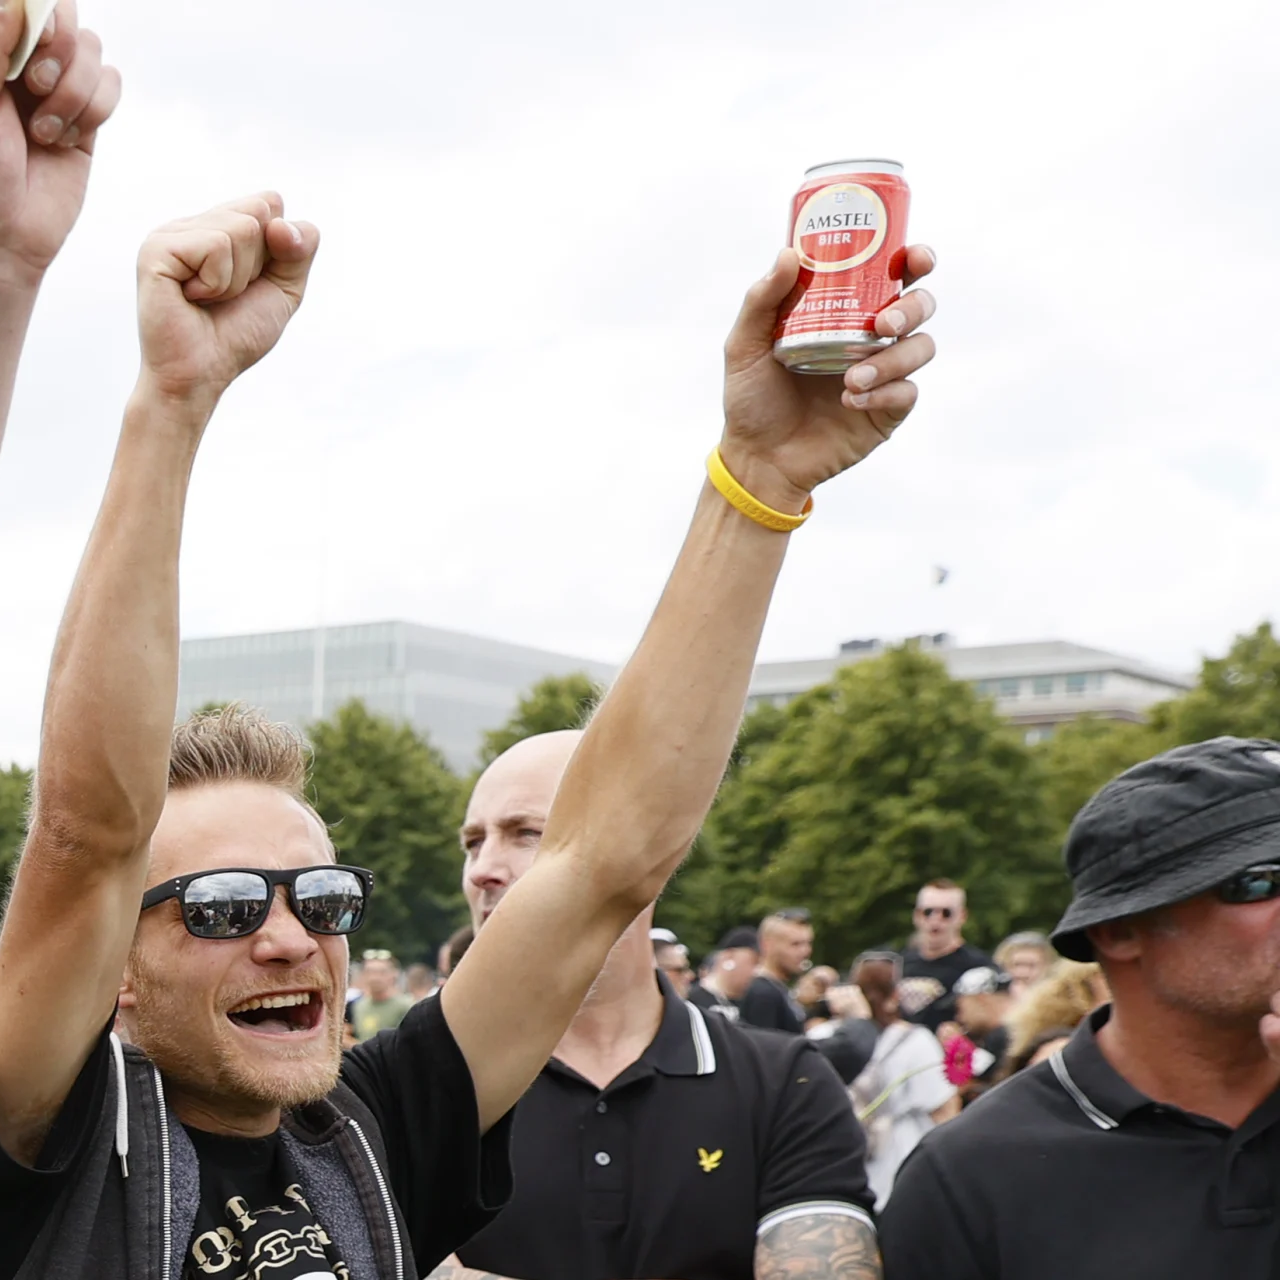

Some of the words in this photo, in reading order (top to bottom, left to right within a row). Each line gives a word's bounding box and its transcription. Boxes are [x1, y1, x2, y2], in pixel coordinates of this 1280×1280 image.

[805, 212, 872, 231] AMSTEL
[818, 232, 852, 247] BIER
[798, 298, 860, 313] PILSENER
